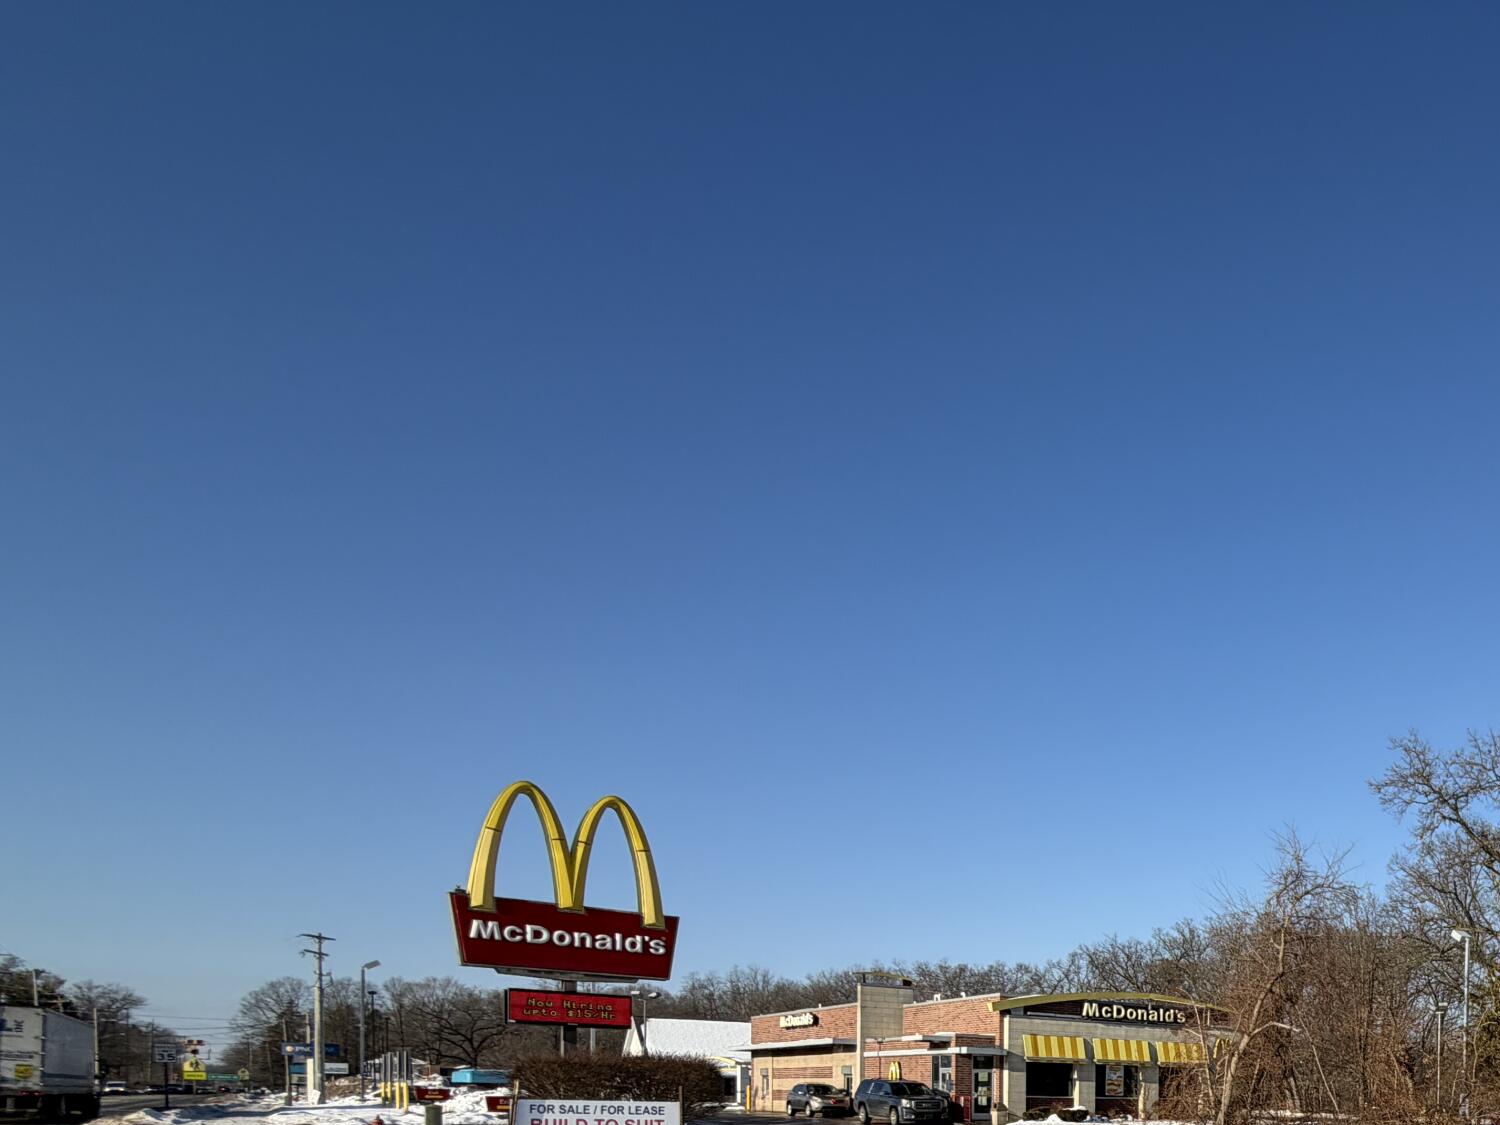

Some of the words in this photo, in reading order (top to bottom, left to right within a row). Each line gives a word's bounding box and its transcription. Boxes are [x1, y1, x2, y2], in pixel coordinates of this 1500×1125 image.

[469, 919, 667, 955] McDonald's
[528, 998, 553, 1007] Now
[563, 1000, 613, 1011] Hiring
[1082, 1002, 1186, 1023] McDonald's
[157, 1053, 176, 1061] 35
[529, 1104, 556, 1115] FOR
[559, 1104, 591, 1115] SALE
[600, 1105, 625, 1115] FOR
[628, 1105, 666, 1116] LEASE
